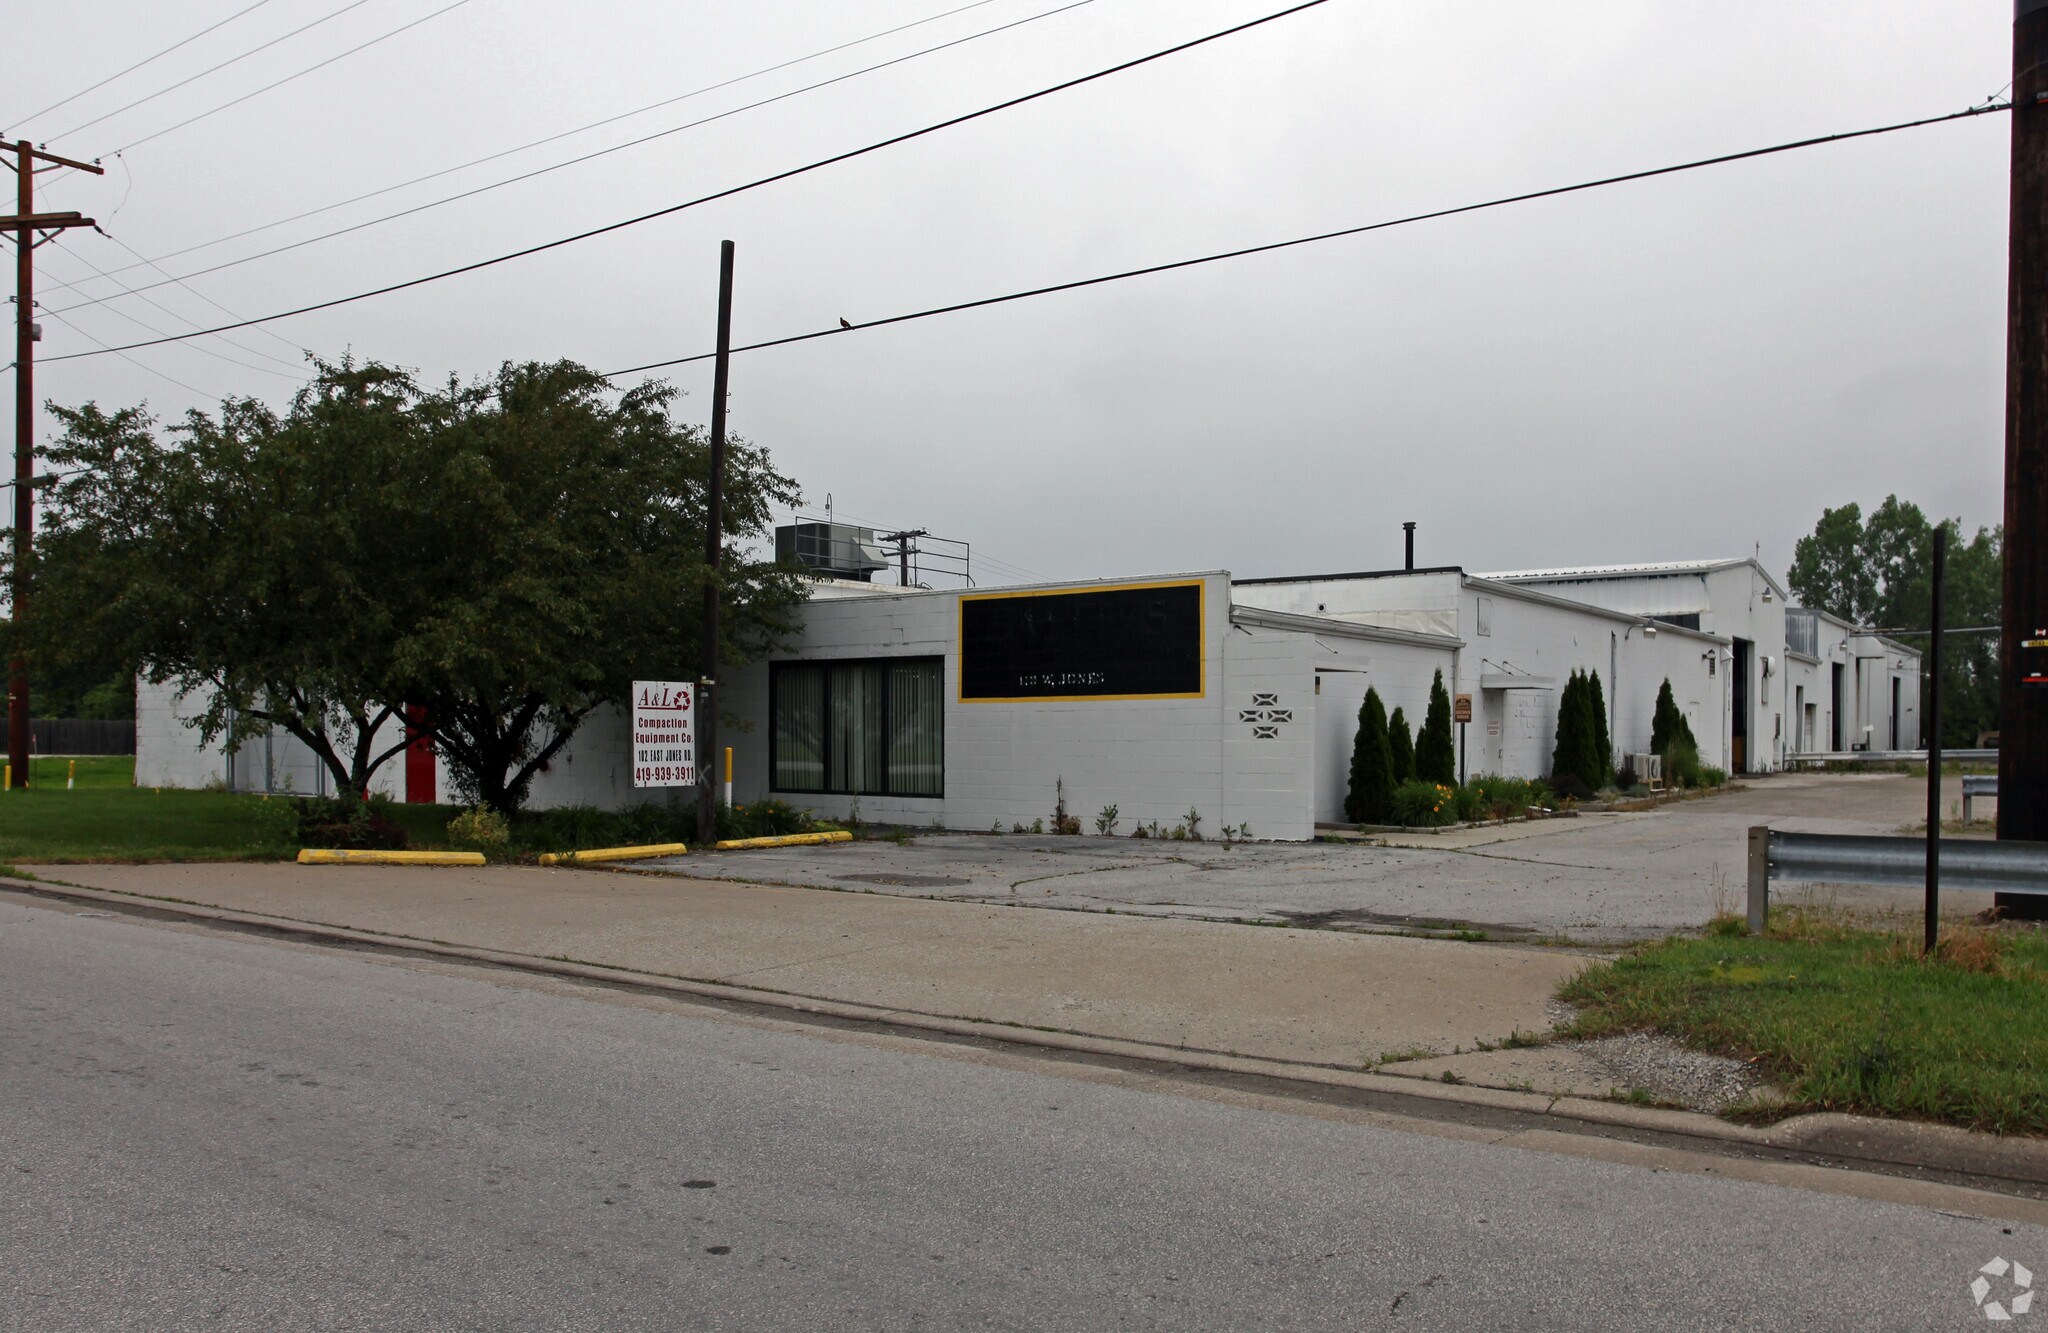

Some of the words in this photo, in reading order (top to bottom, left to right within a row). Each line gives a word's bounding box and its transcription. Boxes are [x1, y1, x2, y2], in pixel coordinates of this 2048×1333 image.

[1058, 672, 1104, 685] JONES
[638, 687, 671, 706] A&L
[638, 717, 688, 729] Compaction
[635, 732, 679, 744] Equipment
[681, 732, 694, 744] Co.
[638, 750, 648, 762] 102
[650, 750, 663, 762] EAST
[665, 749, 682, 761] JONES
[684, 749, 694, 761] RD.
[636, 766, 694, 781] 419-939-3911
